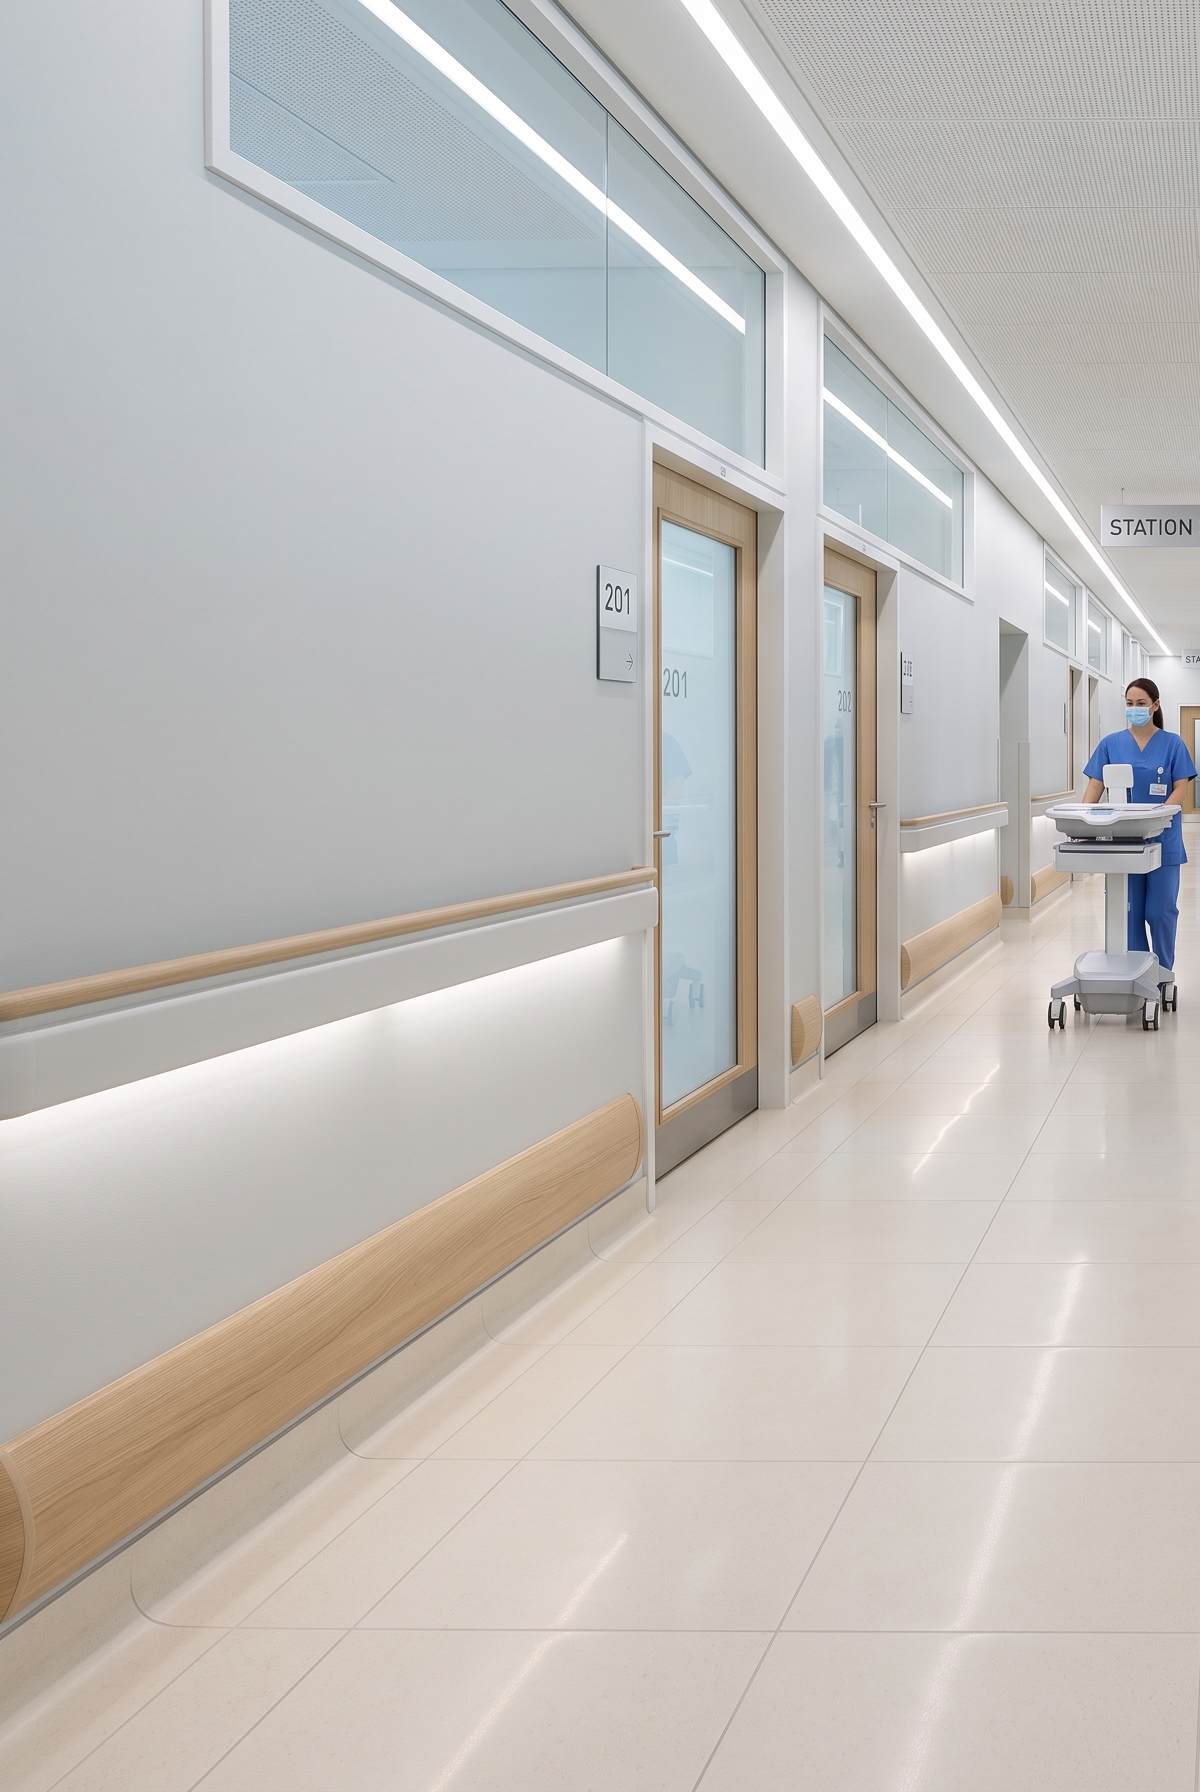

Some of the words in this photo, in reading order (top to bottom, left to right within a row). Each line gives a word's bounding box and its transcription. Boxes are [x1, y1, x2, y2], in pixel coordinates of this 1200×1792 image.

[1110, 518, 1193, 536] STATION
[604, 583, 630, 615] 201
[663, 668, 687, 698] 201
[838, 690, 852, 712] 202
